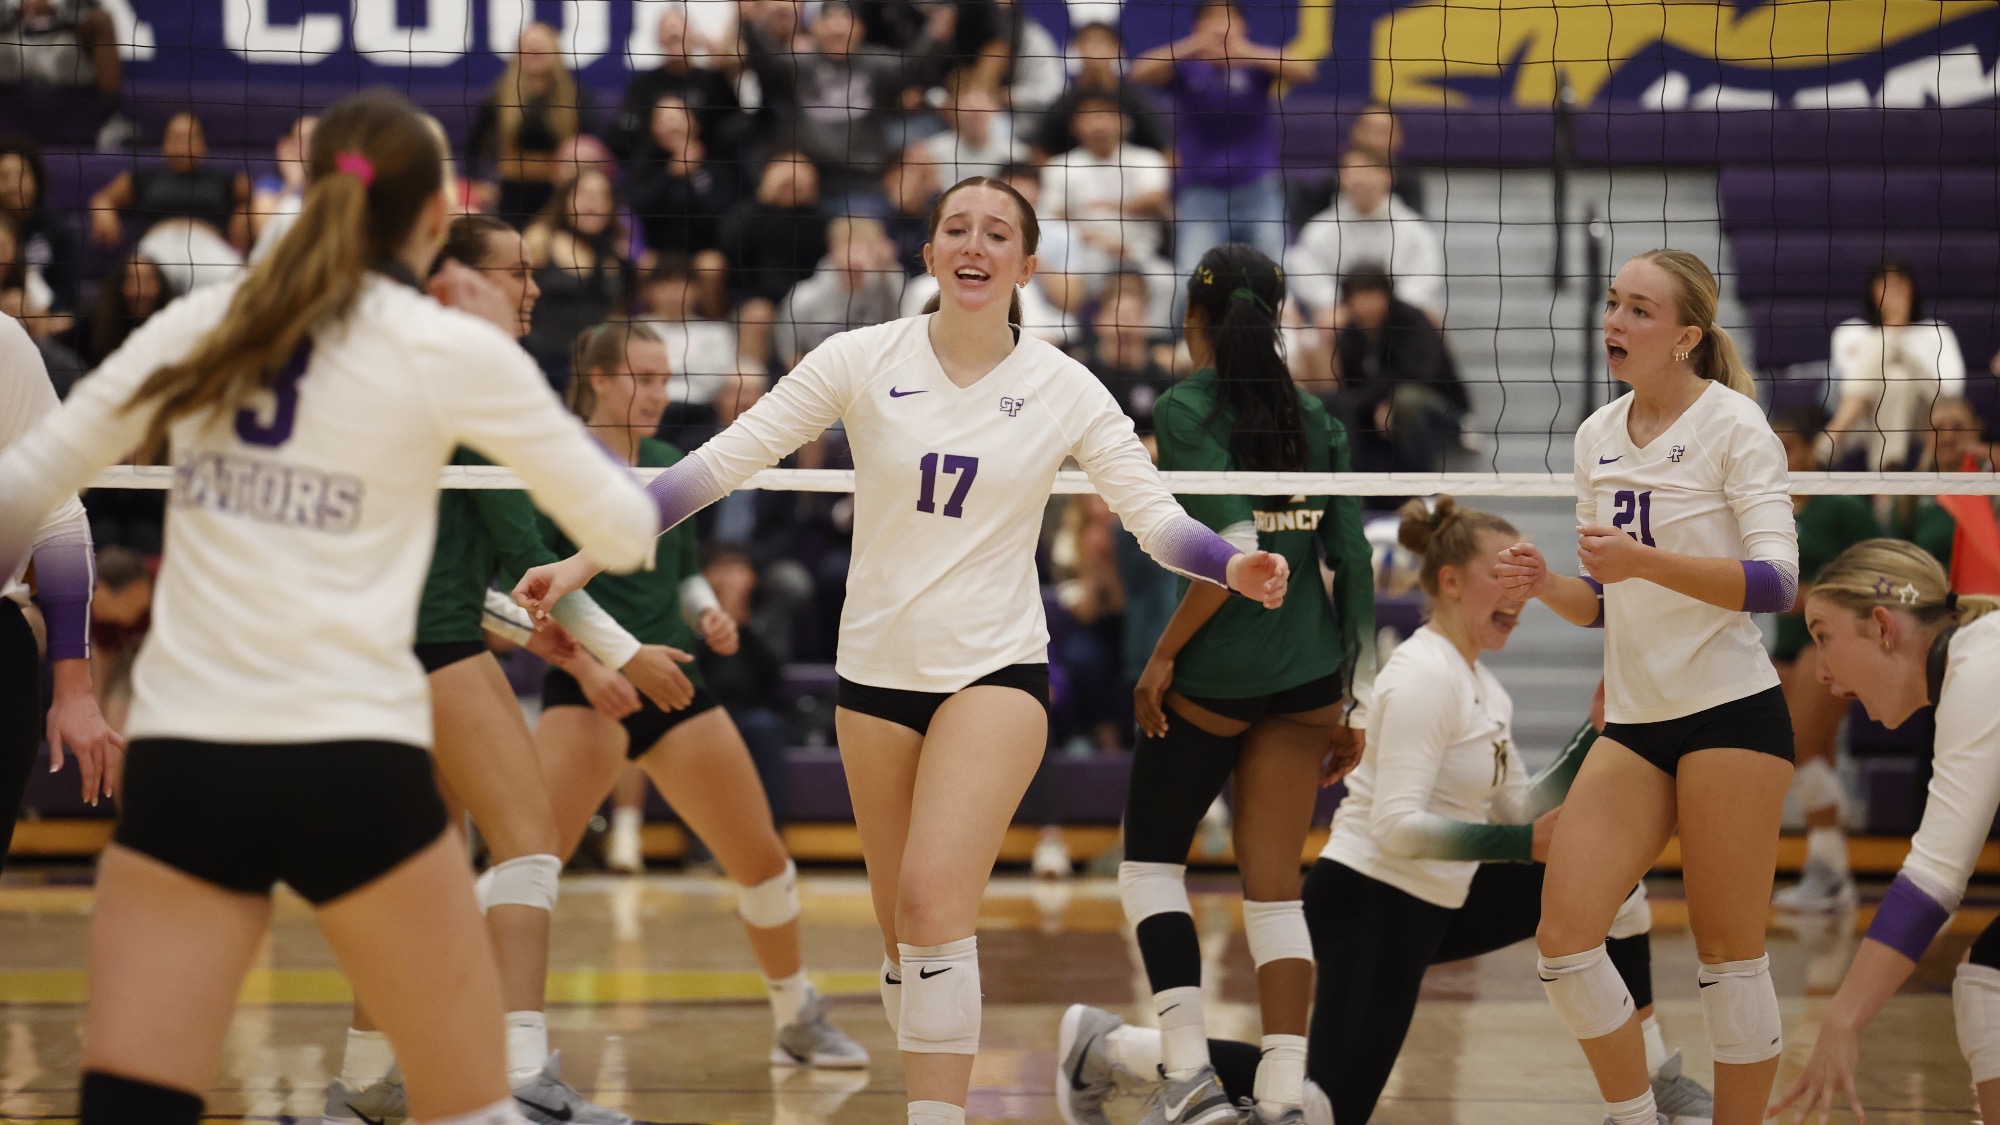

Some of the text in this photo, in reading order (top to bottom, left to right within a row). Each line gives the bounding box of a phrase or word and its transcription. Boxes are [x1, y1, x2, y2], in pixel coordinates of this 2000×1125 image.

[1000, 396, 1024, 417] SF
[917, 452, 979, 519] 17
[1612, 490, 1656, 549] 21
